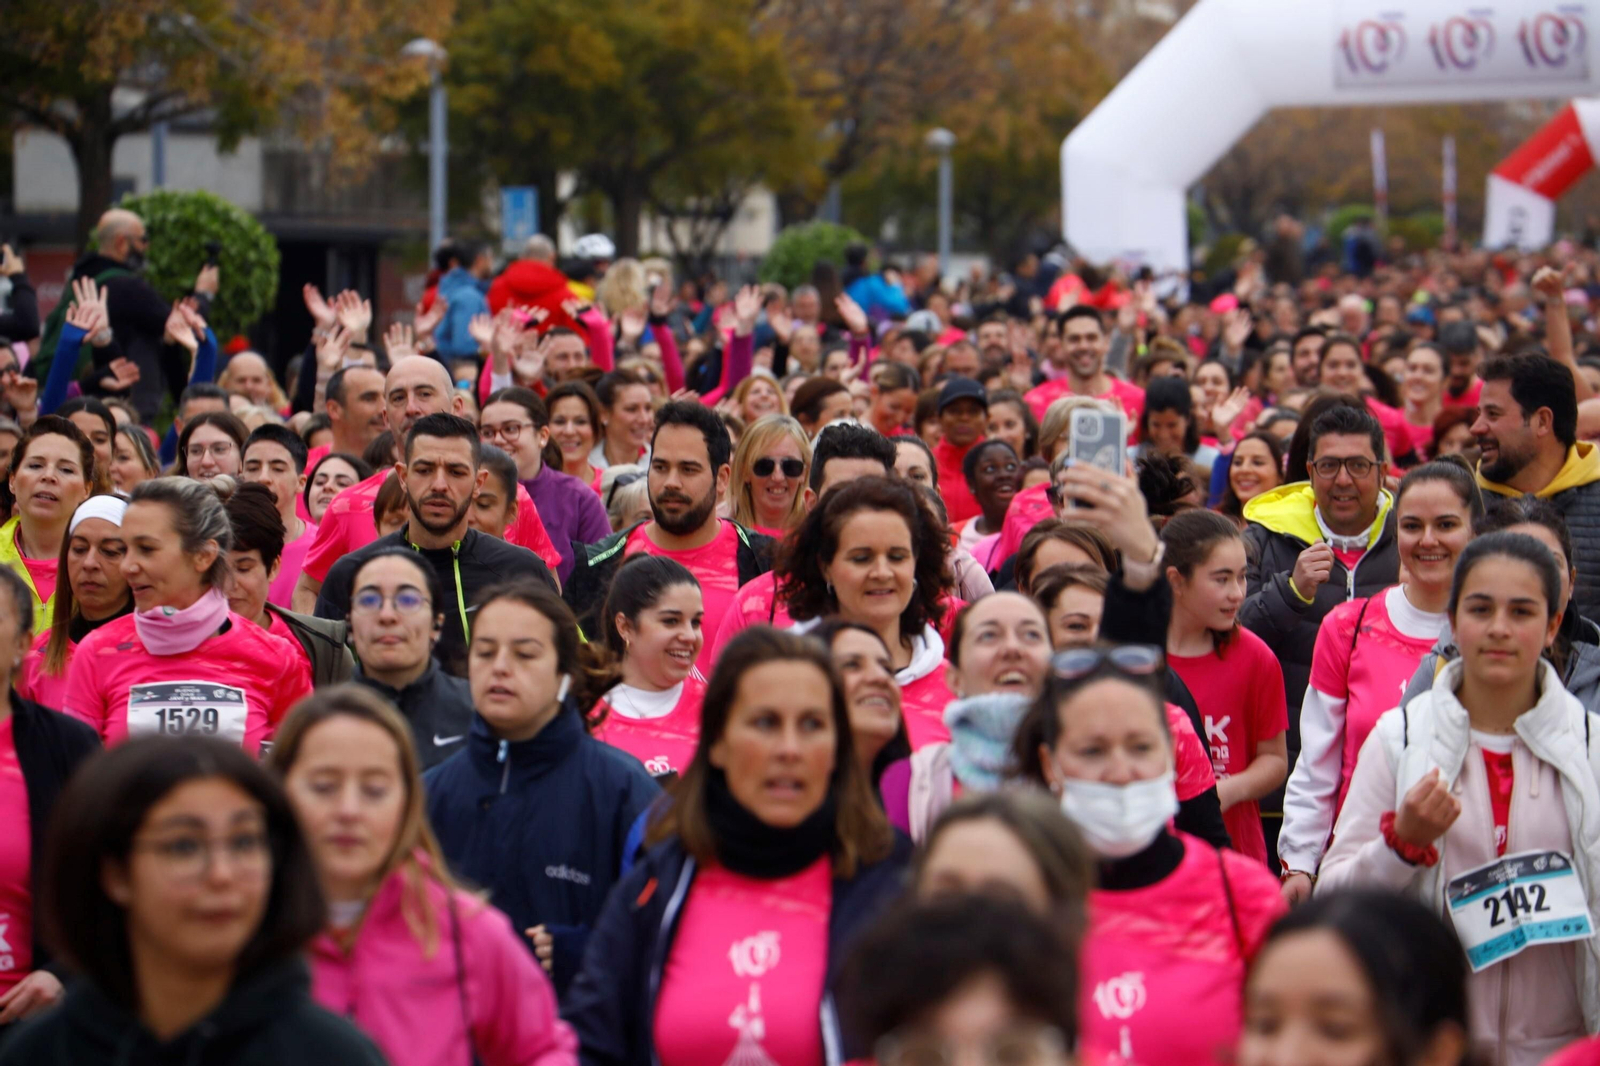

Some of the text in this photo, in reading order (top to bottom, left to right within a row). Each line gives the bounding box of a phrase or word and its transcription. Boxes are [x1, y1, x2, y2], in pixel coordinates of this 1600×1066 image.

[155, 708, 219, 736] 1529
[545, 864, 591, 886] adidas
[1483, 883, 1551, 929] 2142
